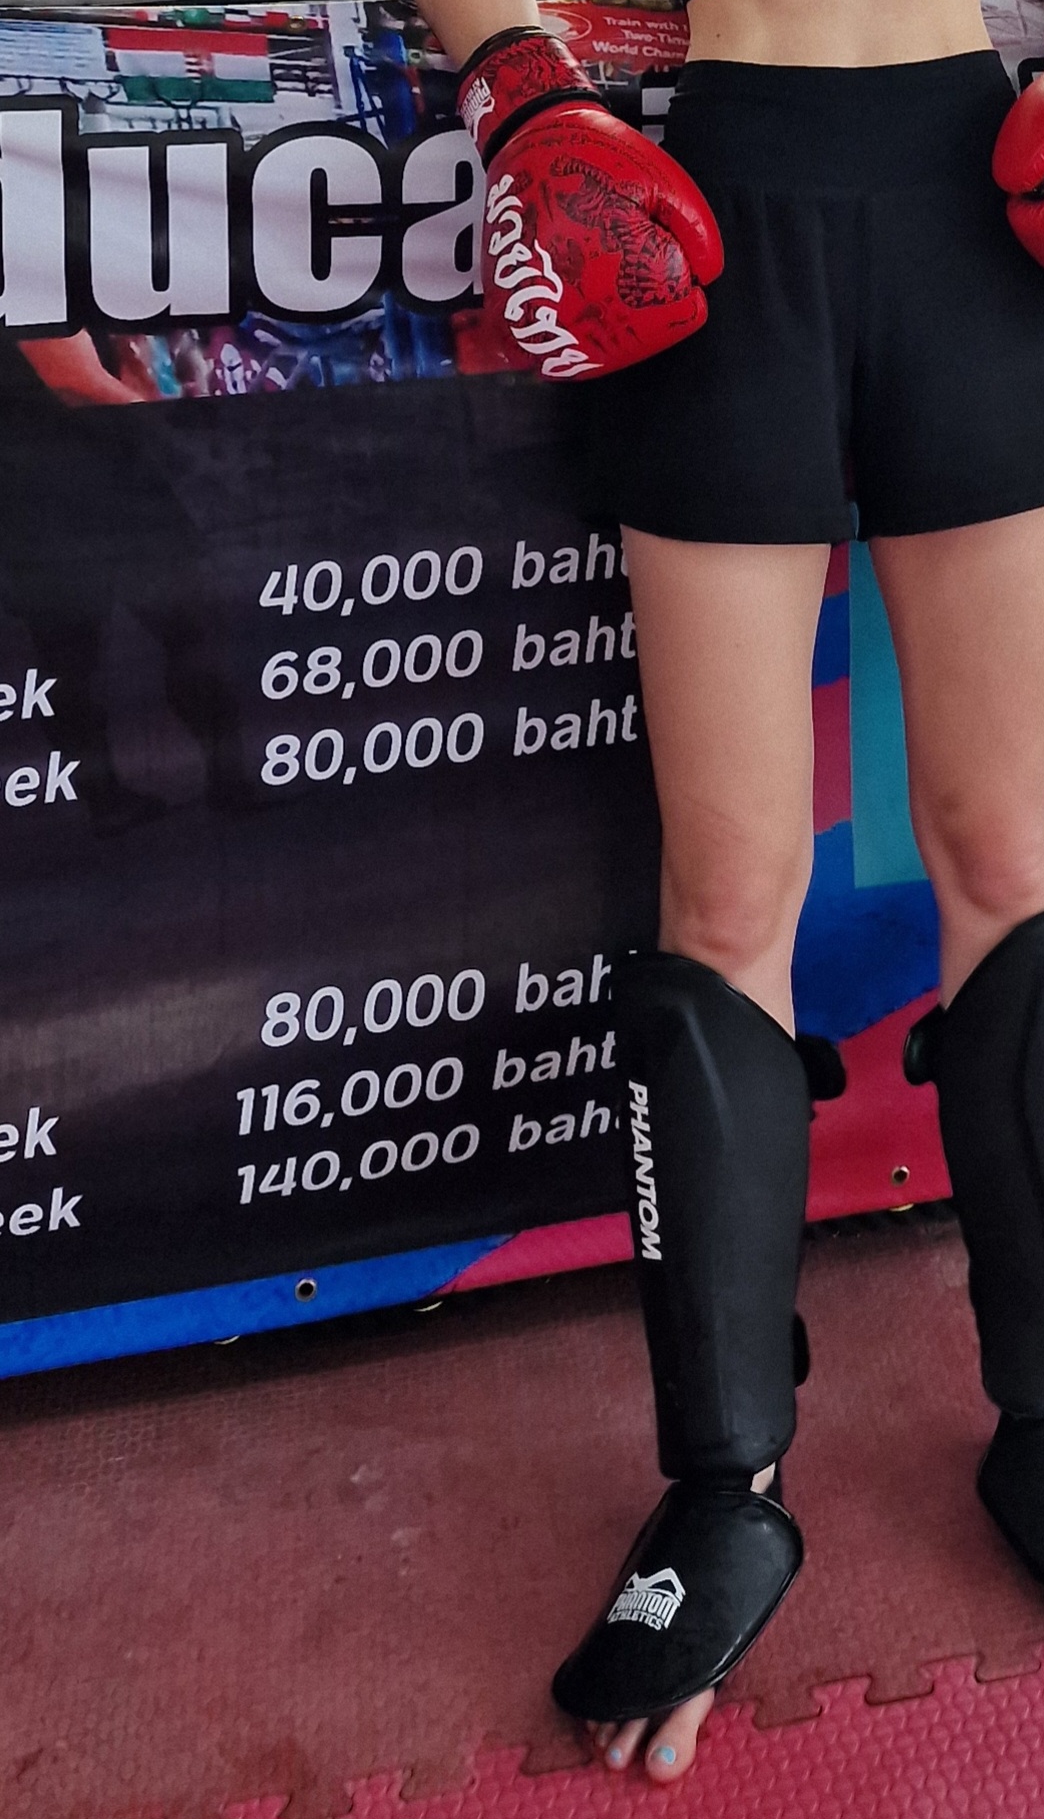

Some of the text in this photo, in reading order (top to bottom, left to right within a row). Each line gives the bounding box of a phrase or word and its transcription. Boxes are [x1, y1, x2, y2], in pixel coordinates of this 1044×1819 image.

[592, 40, 686, 59] World Cham
[603, 16, 641, 28] Train
[259, 545, 484, 617] 40,000
[260, 610, 637, 701] 68,000 baht
[260, 693, 638, 787] 80,000 baht
[260, 953, 613, 1048] 80,000 bah
[236, 1031, 617, 1136] 116,000 baht
[237, 1100, 621, 1205] 140,000 bah
[628, 1080, 663, 1262] PHANTOM
[0, 1187, 84, 1239] ek
